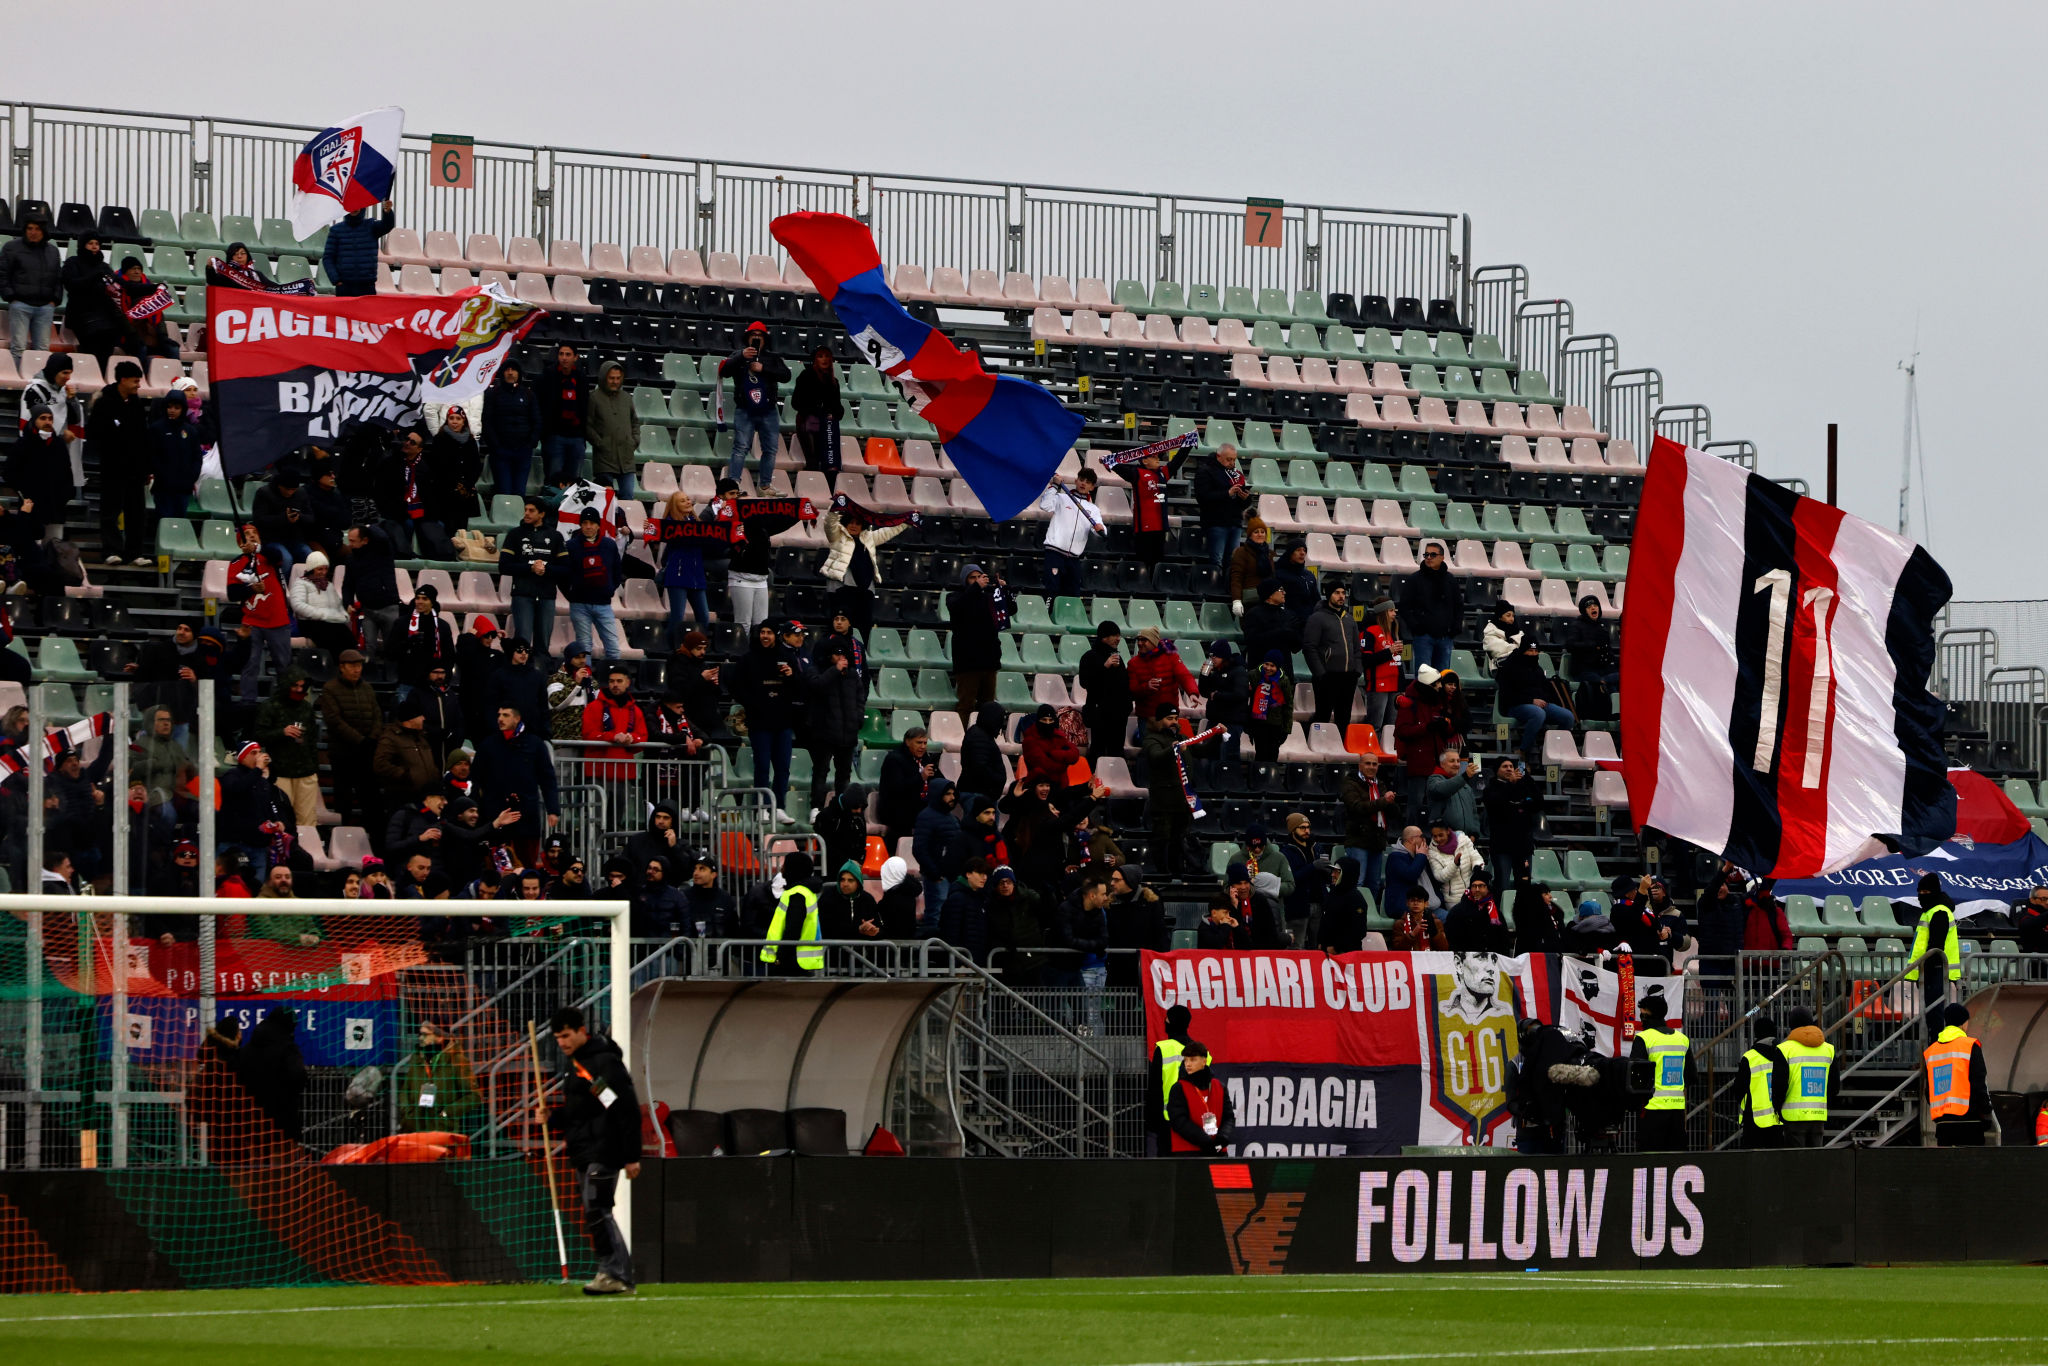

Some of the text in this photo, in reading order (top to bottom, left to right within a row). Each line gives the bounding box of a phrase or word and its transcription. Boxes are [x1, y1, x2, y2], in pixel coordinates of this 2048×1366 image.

[442, 149, 460, 183] 6
[1255, 211, 1272, 243] 7
[410, 308, 462, 340] CLU
[741, 501, 796, 519] CAGLIARI
[664, 523, 728, 542] CAGLIARI
[1753, 568, 1834, 789] 11
[1824, 867, 1914, 886] CUORE
[166, 968, 329, 993] POTOSCUSO
[1150, 957, 1411, 1013] CAGLIARI CLUB
[1227, 1076, 1377, 1129] ARBAGIA
[1356, 1165, 1705, 1262] FOLLOW US
